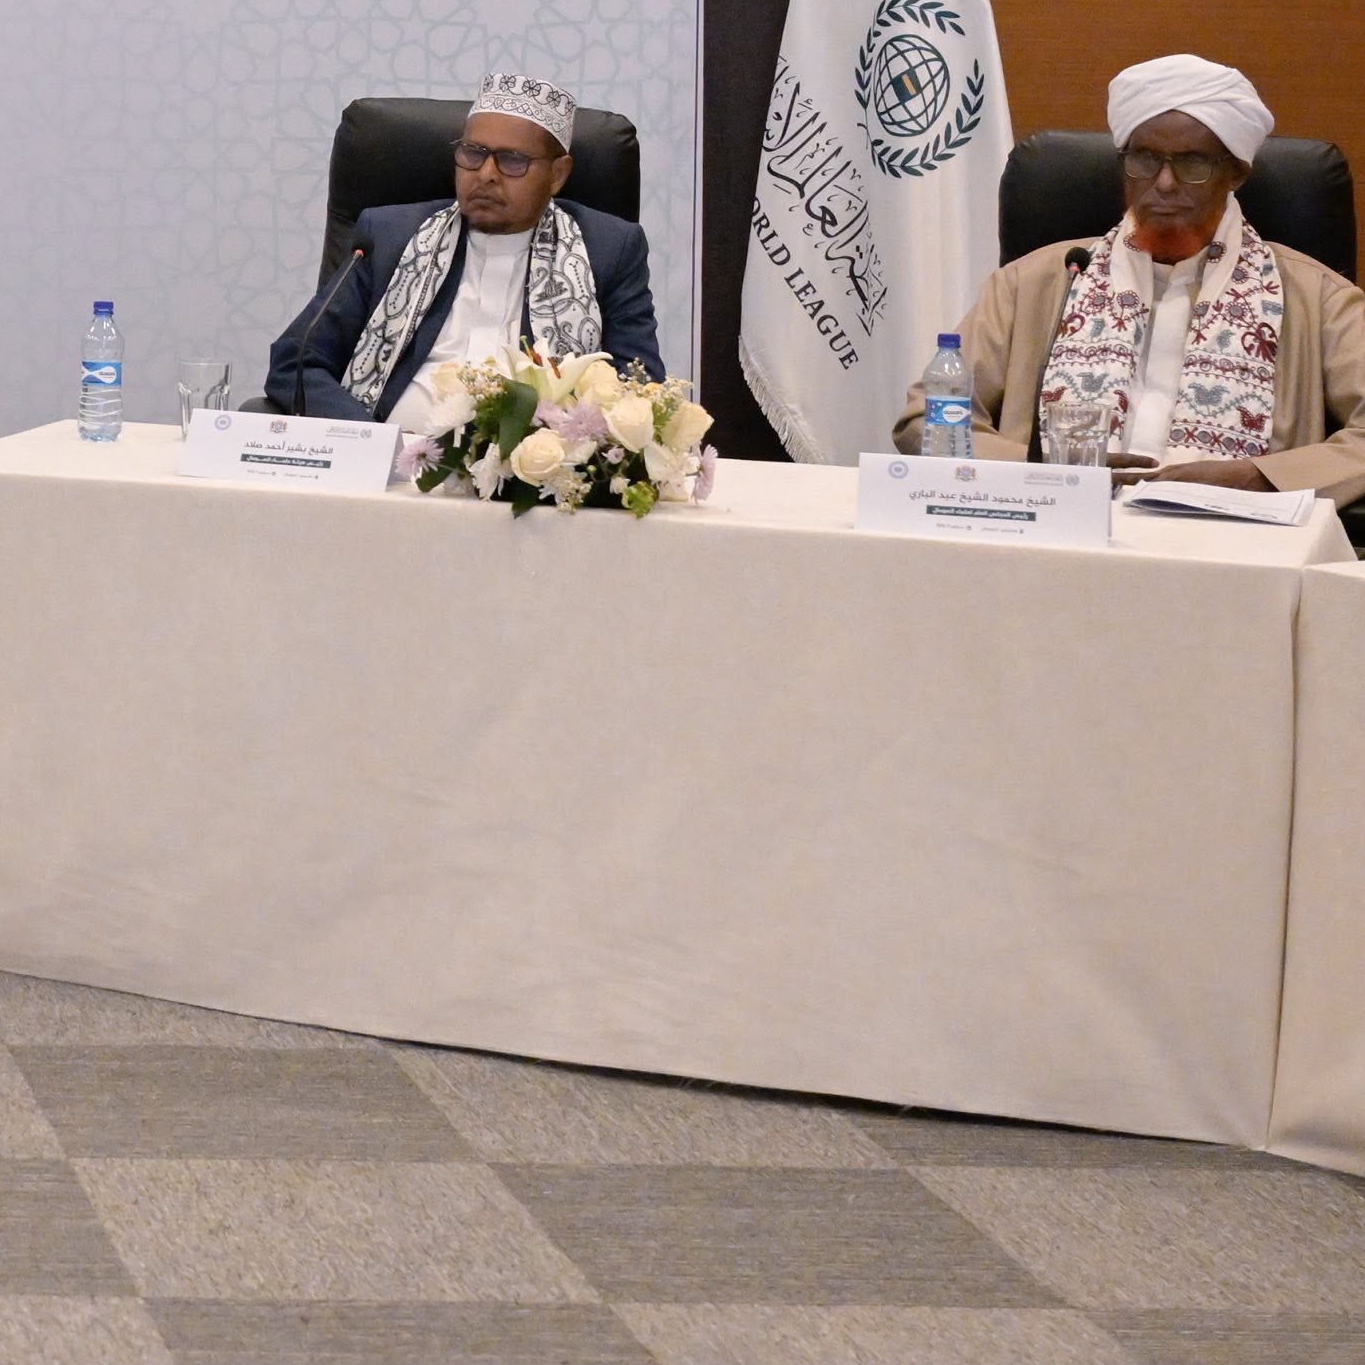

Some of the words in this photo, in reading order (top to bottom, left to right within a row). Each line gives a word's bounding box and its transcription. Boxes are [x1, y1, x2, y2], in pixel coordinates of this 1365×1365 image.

[751, 195, 792, 267] ORLD
[784, 267, 859, 370] LEAGUE
[959, 491, 989, 503] الشيخ
[992, 495, 1024, 505] محمود
[1026, 494, 1056, 507] الشيخ
